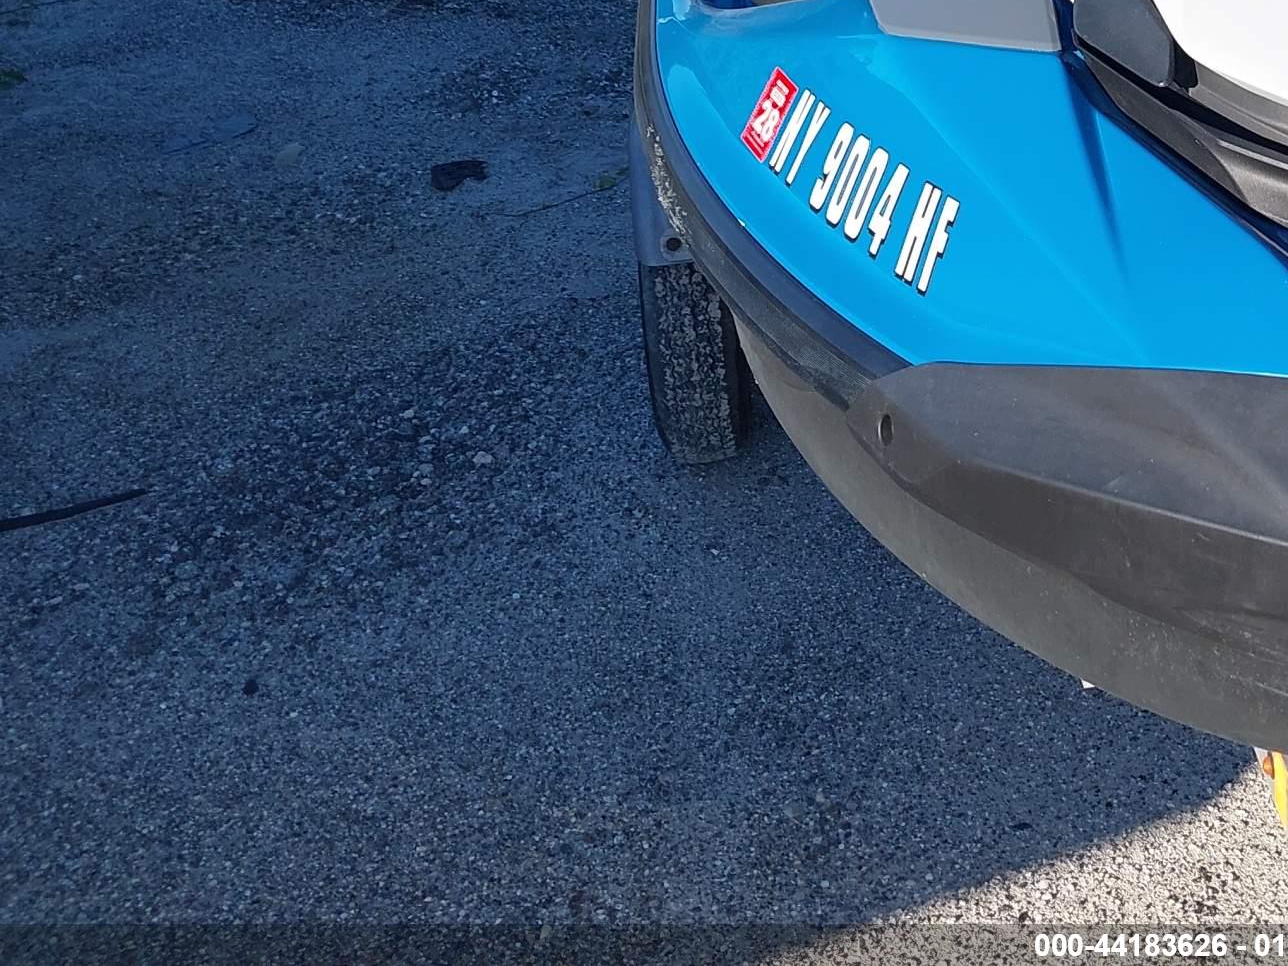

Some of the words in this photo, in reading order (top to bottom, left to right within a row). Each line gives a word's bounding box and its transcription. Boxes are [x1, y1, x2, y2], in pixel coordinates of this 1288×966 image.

[769, 89, 831, 185] NY
[809, 121, 910, 257] 9004
[894, 180, 960, 293] HF
